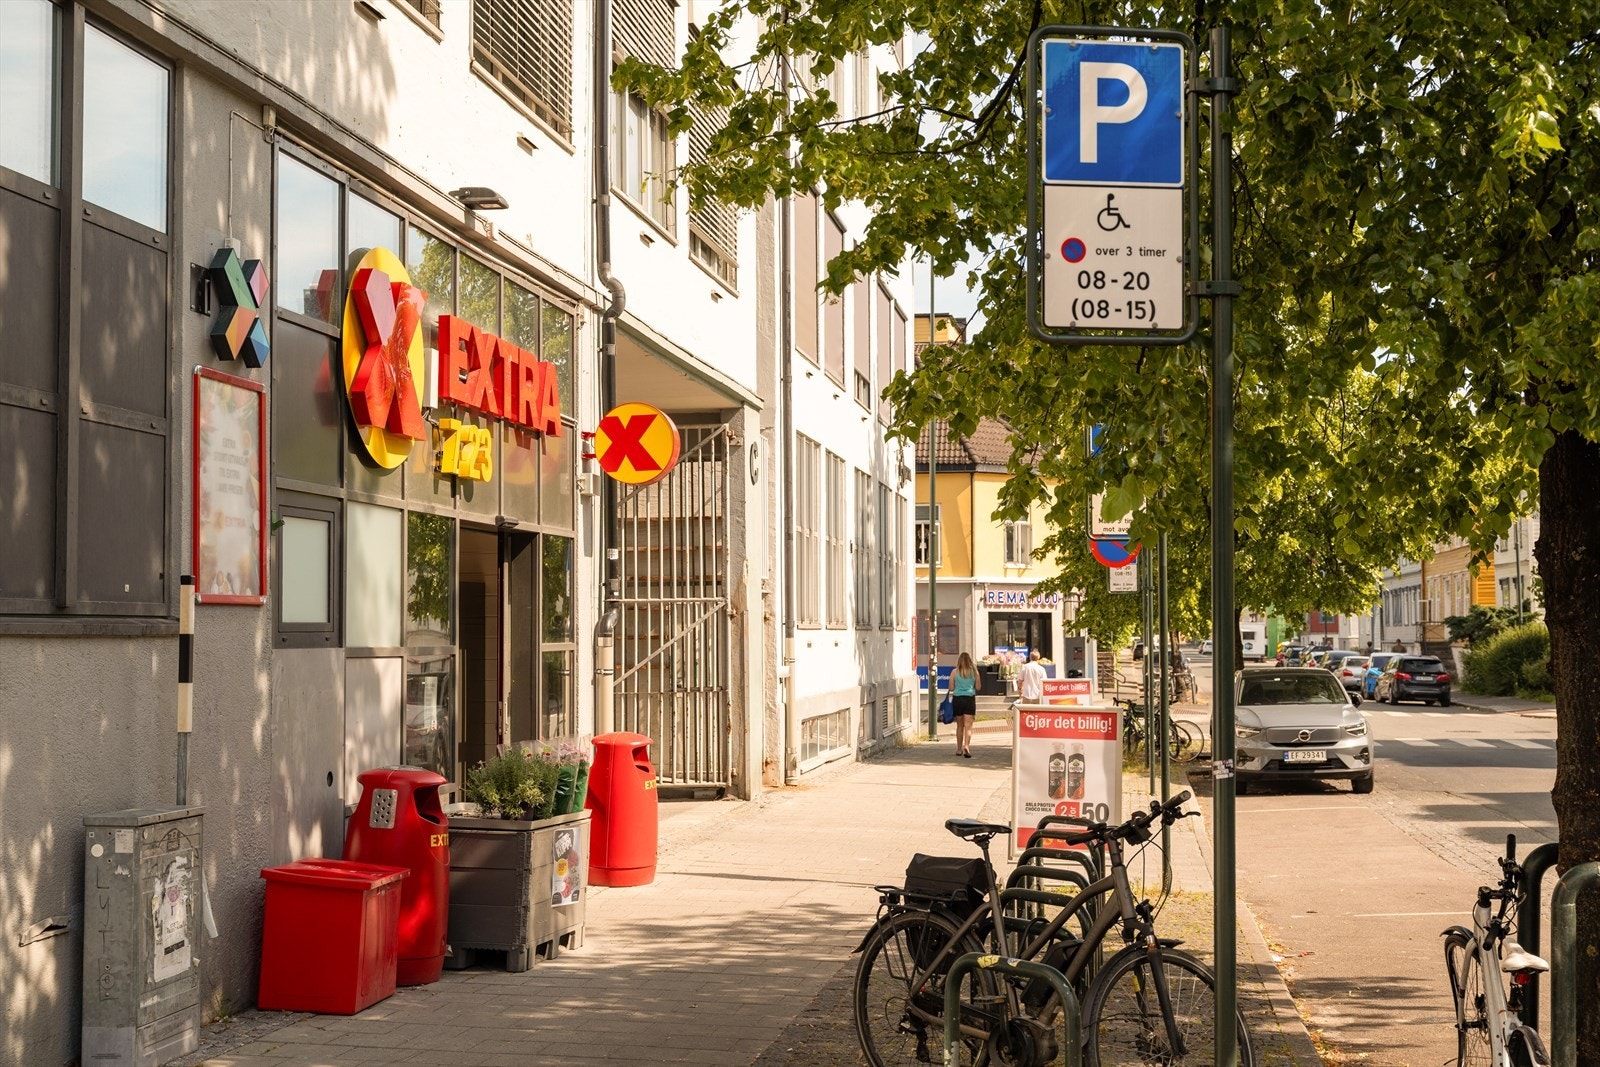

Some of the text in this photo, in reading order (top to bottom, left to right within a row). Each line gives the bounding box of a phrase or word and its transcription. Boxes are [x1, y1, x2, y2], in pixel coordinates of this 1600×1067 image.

[1080, 61, 1148, 163] P
[1095, 246, 1167, 257] over 3 timer
[1077, 270, 1150, 291] 08-20
[1071, 298, 1156, 322] (08-15)
[438, 314, 562, 437] EXTRA
[750, 441, 759, 486] C
[988, 591, 1026, 604] REMA
[1045, 683, 1088, 692] Gjør det billig!
[1025, 715, 1112, 733] Gjør det billig!
[1291, 751, 1324, 759] EF 29341
[1060, 805, 1068, 816] 2
[1082, 802, 1110, 822] 50
